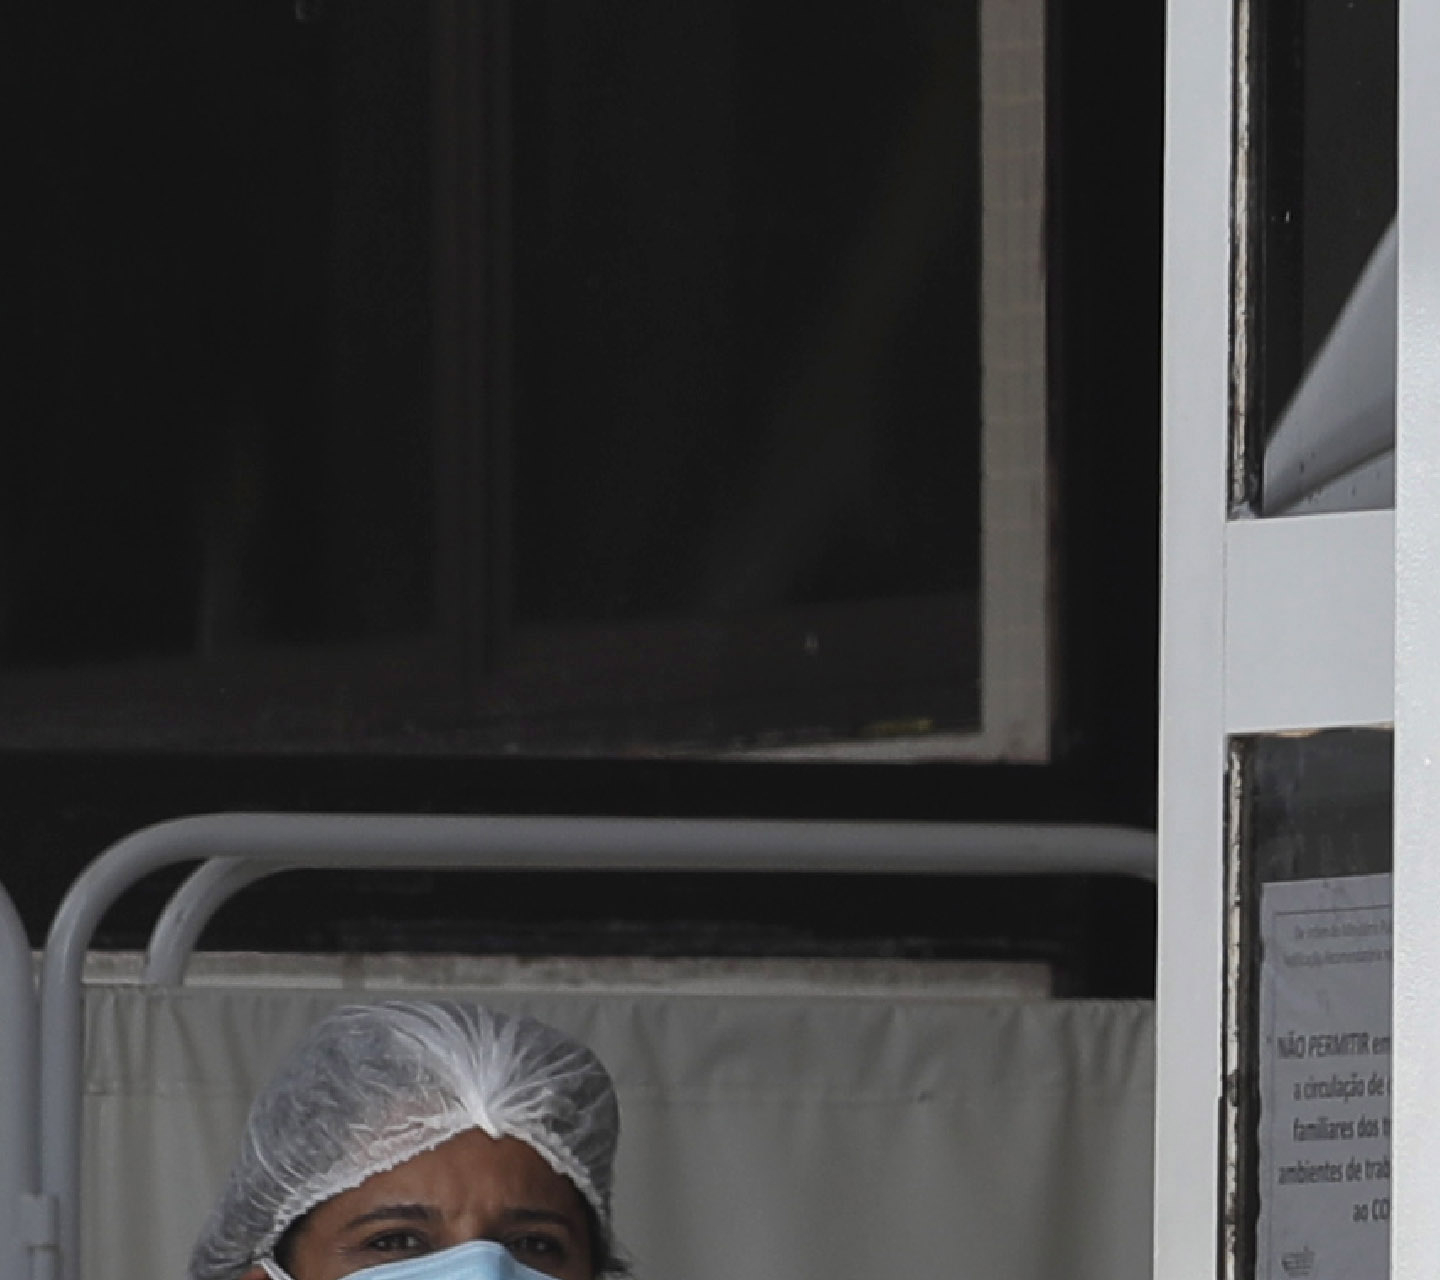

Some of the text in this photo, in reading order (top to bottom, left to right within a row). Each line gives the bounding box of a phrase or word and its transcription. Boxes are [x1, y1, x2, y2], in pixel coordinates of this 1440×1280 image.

[1277, 1030, 1305, 1059] NÃO
[1308, 1031, 1369, 1057] PERMITIR
[1293, 1081, 1302, 1101] a
[1303, 1072, 1365, 1104] circulação
[1367, 1070, 1385, 1097] de
[1293, 1115, 1354, 1142] familiares
[1356, 1113, 1379, 1139] dos
[1277, 1159, 1343, 1185] ambientes
[1345, 1155, 1363, 1182] de
[1352, 1203, 1369, 1223] ao
